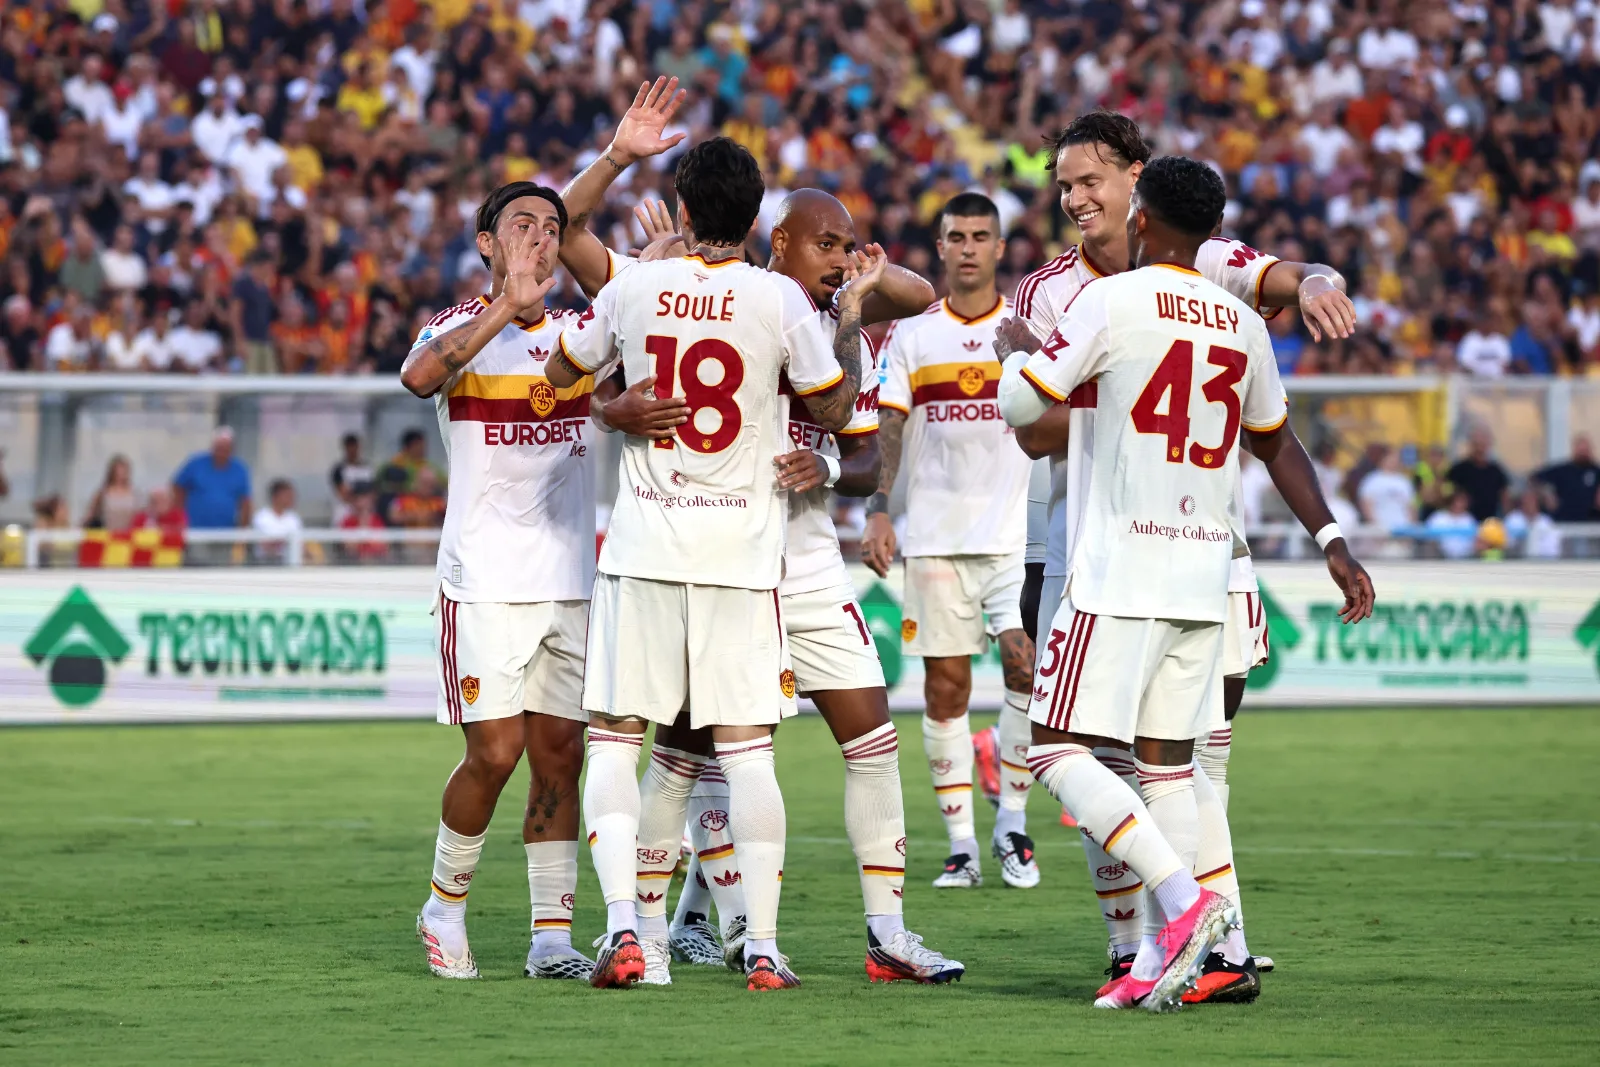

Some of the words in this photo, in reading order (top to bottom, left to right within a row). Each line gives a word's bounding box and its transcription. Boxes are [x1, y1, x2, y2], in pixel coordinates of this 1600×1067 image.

[656, 289, 735, 322] SOULÉ
[1155, 291, 1240, 334] WESLEY
[645, 334, 745, 454] 18
[1130, 339, 1249, 470] 43
[484, 419, 586, 446] EUROBET
[634, 485, 677, 510] Auberge
[677, 495, 748, 509] Collection
[1128, 519, 1180, 541] Auberge
[1182, 525, 1231, 542] Collection
[137, 609, 388, 677] TECNOCASA
